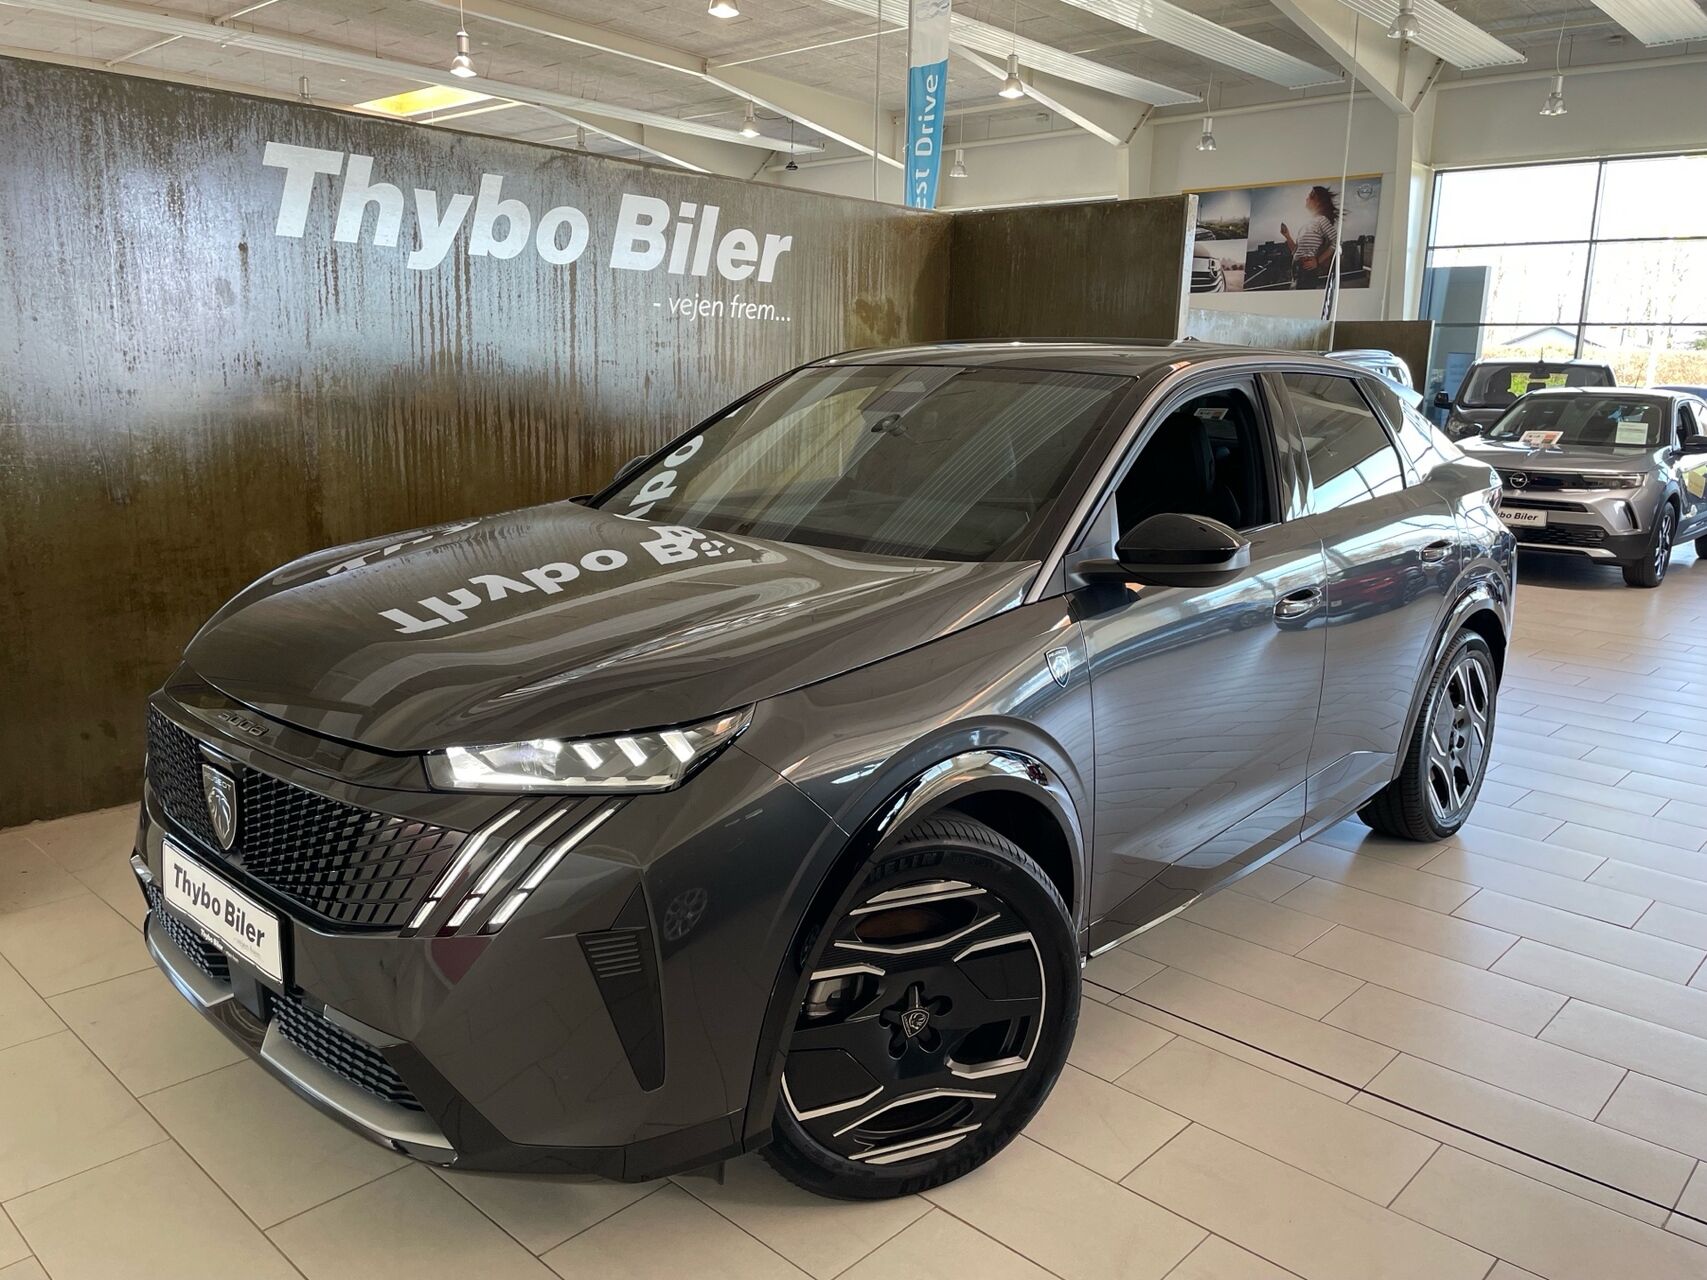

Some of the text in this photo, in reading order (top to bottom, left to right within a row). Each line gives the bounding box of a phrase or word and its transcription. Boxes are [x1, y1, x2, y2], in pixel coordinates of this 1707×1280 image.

[914, 74, 939, 209] est Drive
[262, 141, 793, 282] Thybo Biler
[669, 292, 723, 322] vejen
[730, 294, 790, 322] frem...
[1514, 512, 1538, 521] Biler
[173, 863, 265, 947] Thybo Biler
